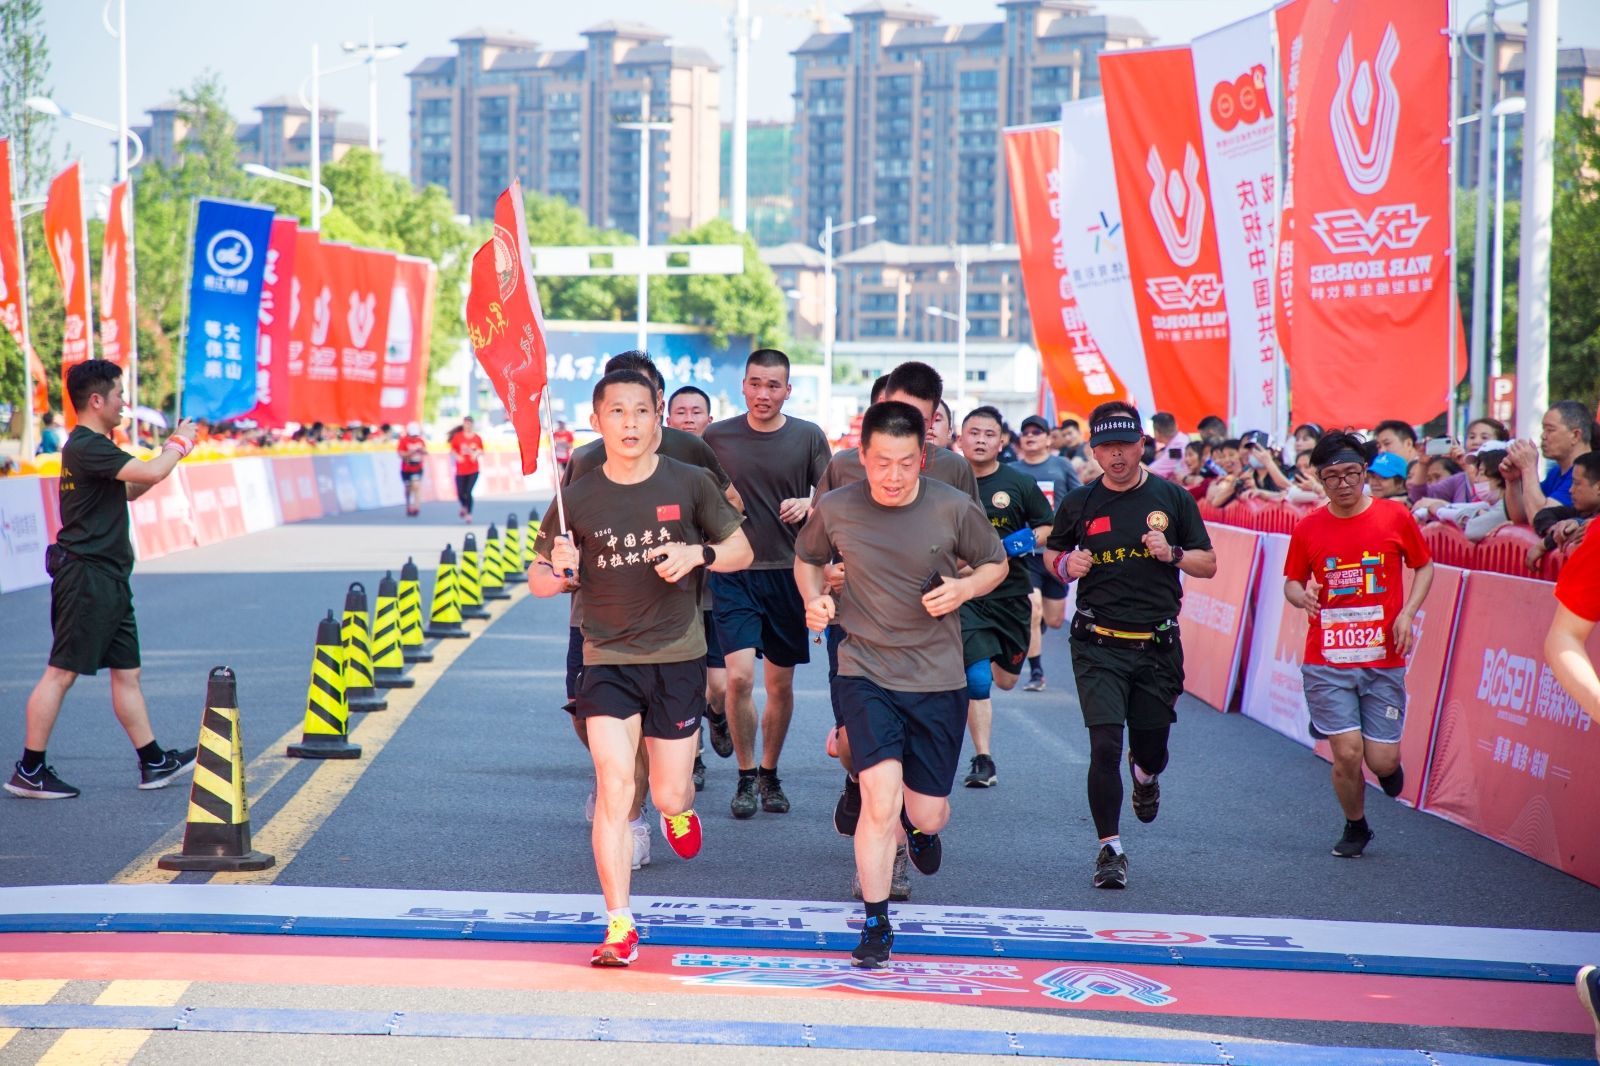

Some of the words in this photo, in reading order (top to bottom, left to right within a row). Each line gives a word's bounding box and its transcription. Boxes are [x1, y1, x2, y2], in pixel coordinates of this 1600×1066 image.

[223, 322, 242, 381] 大王山
[606, 526, 673, 551] 中国老兵
[1341, 568, 1363, 579] 2021
[1323, 627, 1384, 647] B10324
[394, 908, 812, 930] 博森体育
[890, 967, 1018, 979] WAR
